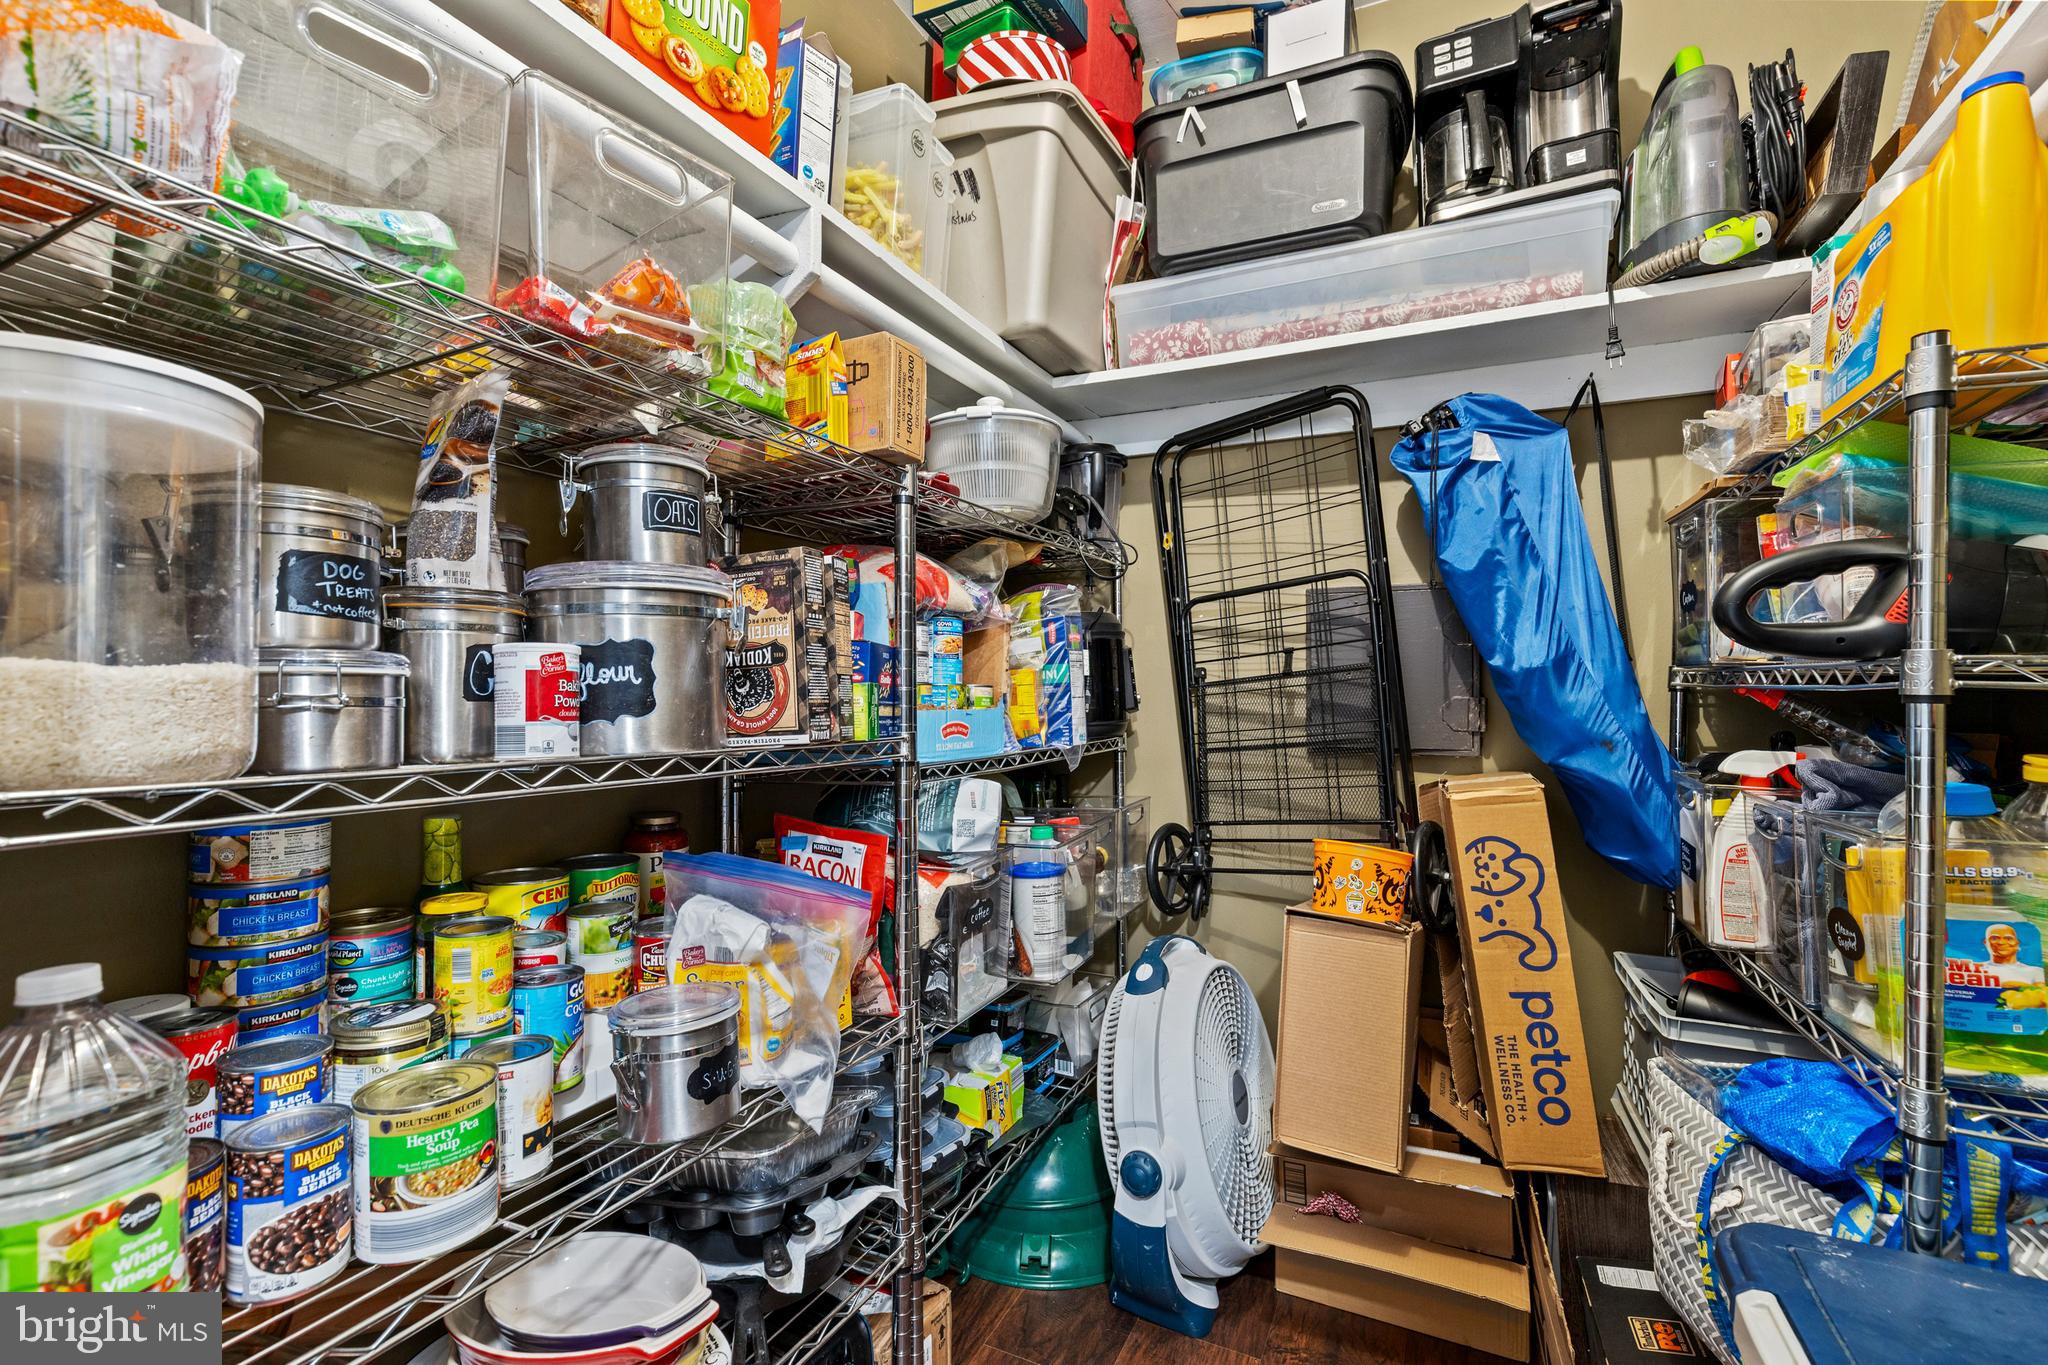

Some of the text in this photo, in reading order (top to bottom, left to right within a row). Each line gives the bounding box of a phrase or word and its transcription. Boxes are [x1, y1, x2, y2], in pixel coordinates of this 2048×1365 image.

[678, 18, 726, 57] CRACKERS
[1314, 200, 1345, 211] Sterilite
[796, 346, 824, 361] SIMMS
[906, 354, 915, 446] 1-800-424-9300
[653, 501, 699, 527] OATS
[323, 561, 366, 581] DOG
[315, 581, 375, 602] TREATS
[541, 655, 565, 665] Baker's
[541, 664, 566, 676] Corner
[580, 661, 642, 702] flour
[1902, 680, 1934, 690] HDX
[559, 709, 577, 717] double
[745, 717, 767, 729] WHOLE
[810, 730, 830, 741] KODIAK
[813, 843, 843, 854] KIRKLAND
[790, 854, 857, 887] BACON
[249, 889, 299, 901] KIRKLAND
[232, 908, 310, 927] CHICKEN BREAST
[970, 907, 990, 924] coffee
[268, 944, 312, 959] KIRKLAND
[342, 950, 362, 958] Planet
[683, 948, 705, 957] Baker's
[682, 957, 705, 969] Corner
[1947, 960, 1989, 974] Mr.
[252, 972, 294, 985] CHICKEN
[361, 969, 405, 985] Chunk Light
[251, 1008, 300, 1025] KIRKLAND
[282, 1026, 311, 1038] EAST
[1507, 1035, 1520, 1059] THE
[1508, 992, 1572, 1126] petco
[263, 1066, 318, 1092] DAKOTA'S
[1494, 1035, 1517, 1127] WELLNESS CO.
[1511, 1063, 1528, 1112] HEALTH
[269, 1091, 312, 1109] BLACK
[395, 1097, 484, 1129] DEUTSCHE KÜCHE
[406, 1117, 480, 1149] Hearty Pea
[293, 1135, 346, 1169] DAKOTA'S
[426, 1137, 461, 1157] Soup
[298, 1170, 343, 1197] BEANS
[301, 1162, 341, 1186] BLACK
[112, 1241, 169, 1275] White
[1695, 1213, 1717, 1300] IKEA
[102, 1249, 176, 1292] Vinegar
